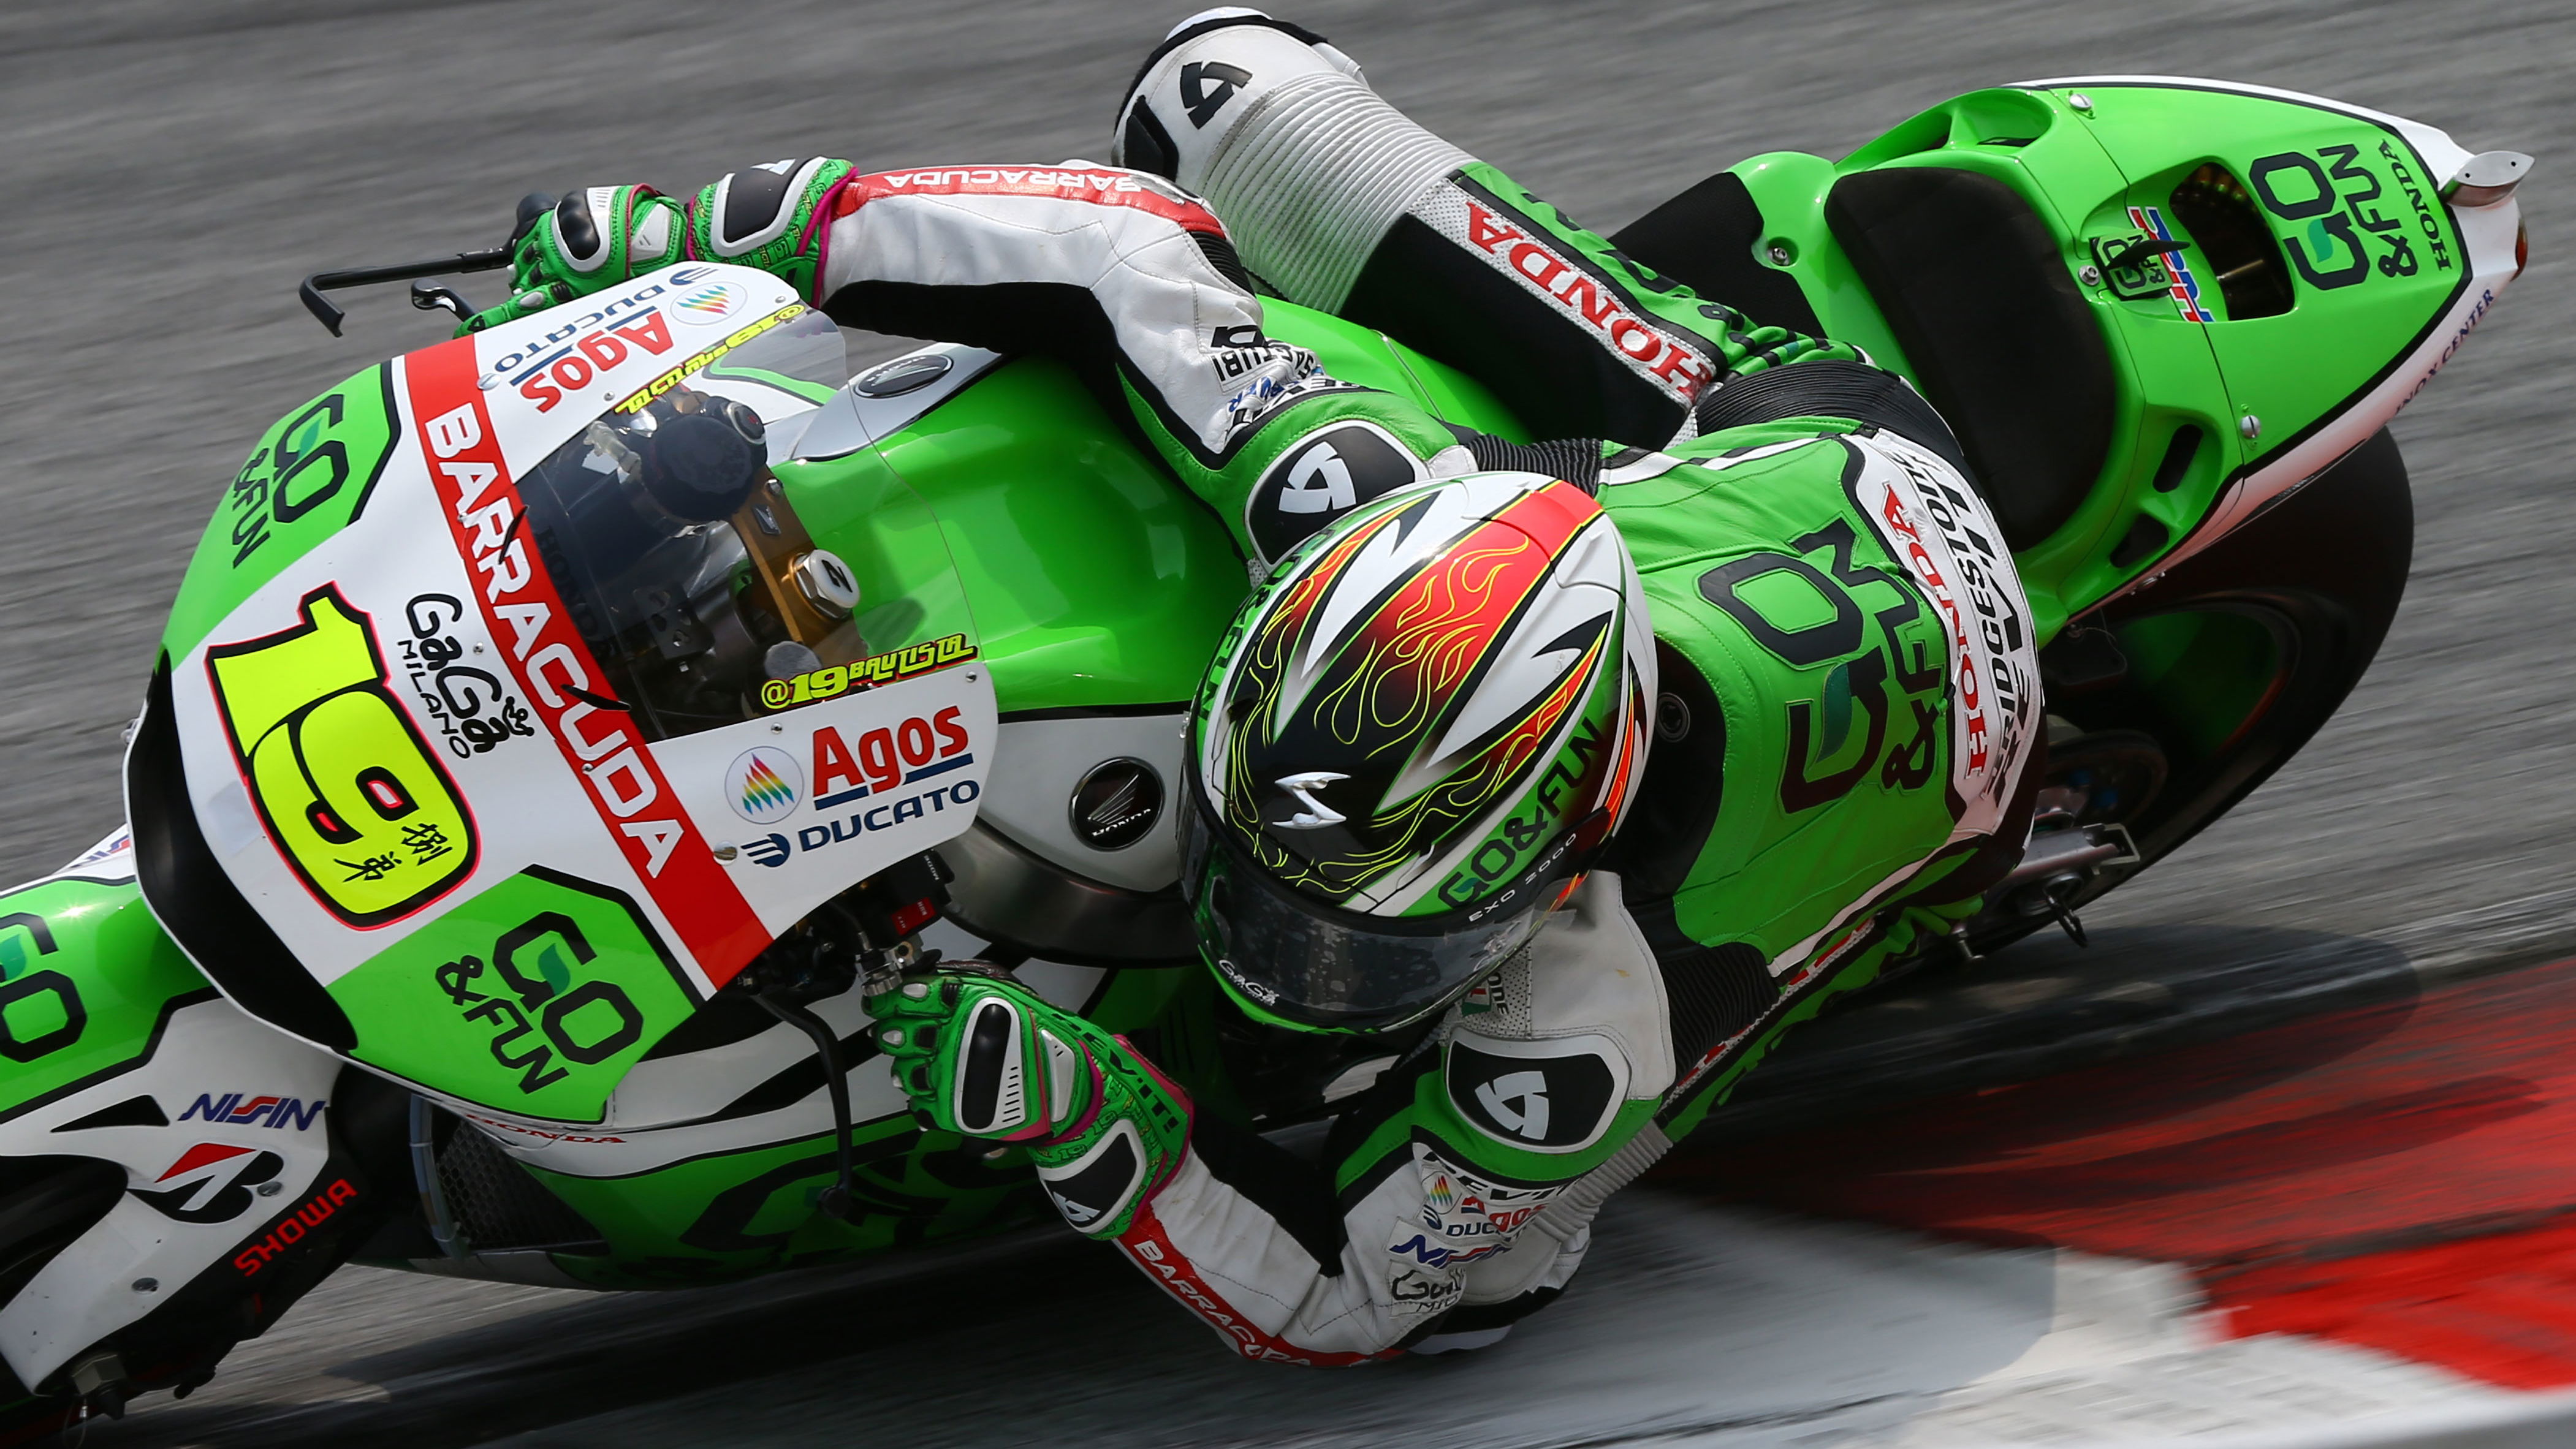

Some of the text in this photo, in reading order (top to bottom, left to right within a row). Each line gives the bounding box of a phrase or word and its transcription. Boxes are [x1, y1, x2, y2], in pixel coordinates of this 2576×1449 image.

[883, 170, 1142, 192] BARRACUDA
[2249, 151, 2371, 290] GO
[2316, 143, 2418, 278] &FUN
[2378, 138, 2452, 271] HONDA
[493, 286, 666, 373] DUCATO
[520, 310, 675, 414] Agos
[1465, 200, 1715, 406] HONDA
[2437, 289, 2496, 364] CENTER
[274, 393, 349, 524] GO
[425, 401, 685, 879] BARRACUDA
[1698, 551, 1889, 815] GO
[1885, 483, 1988, 777] HONDA
[206, 582, 479, 930] 19
[398, 640, 471, 759] MILANO
[812, 705, 970, 794] Agos
[798, 779, 981, 853] DUCATO
[1468, 832, 1578, 923] EXO 2000
[435, 955, 570, 1095] &FUN
[493, 910, 644, 1065] GO
[177, 1093, 326, 1132] NISSIN
[463, 1114, 627, 1144] HONDA
[234, 1178, 359, 1277] SHOWA
[1133, 1241, 1312, 1367] BARRACUDA
